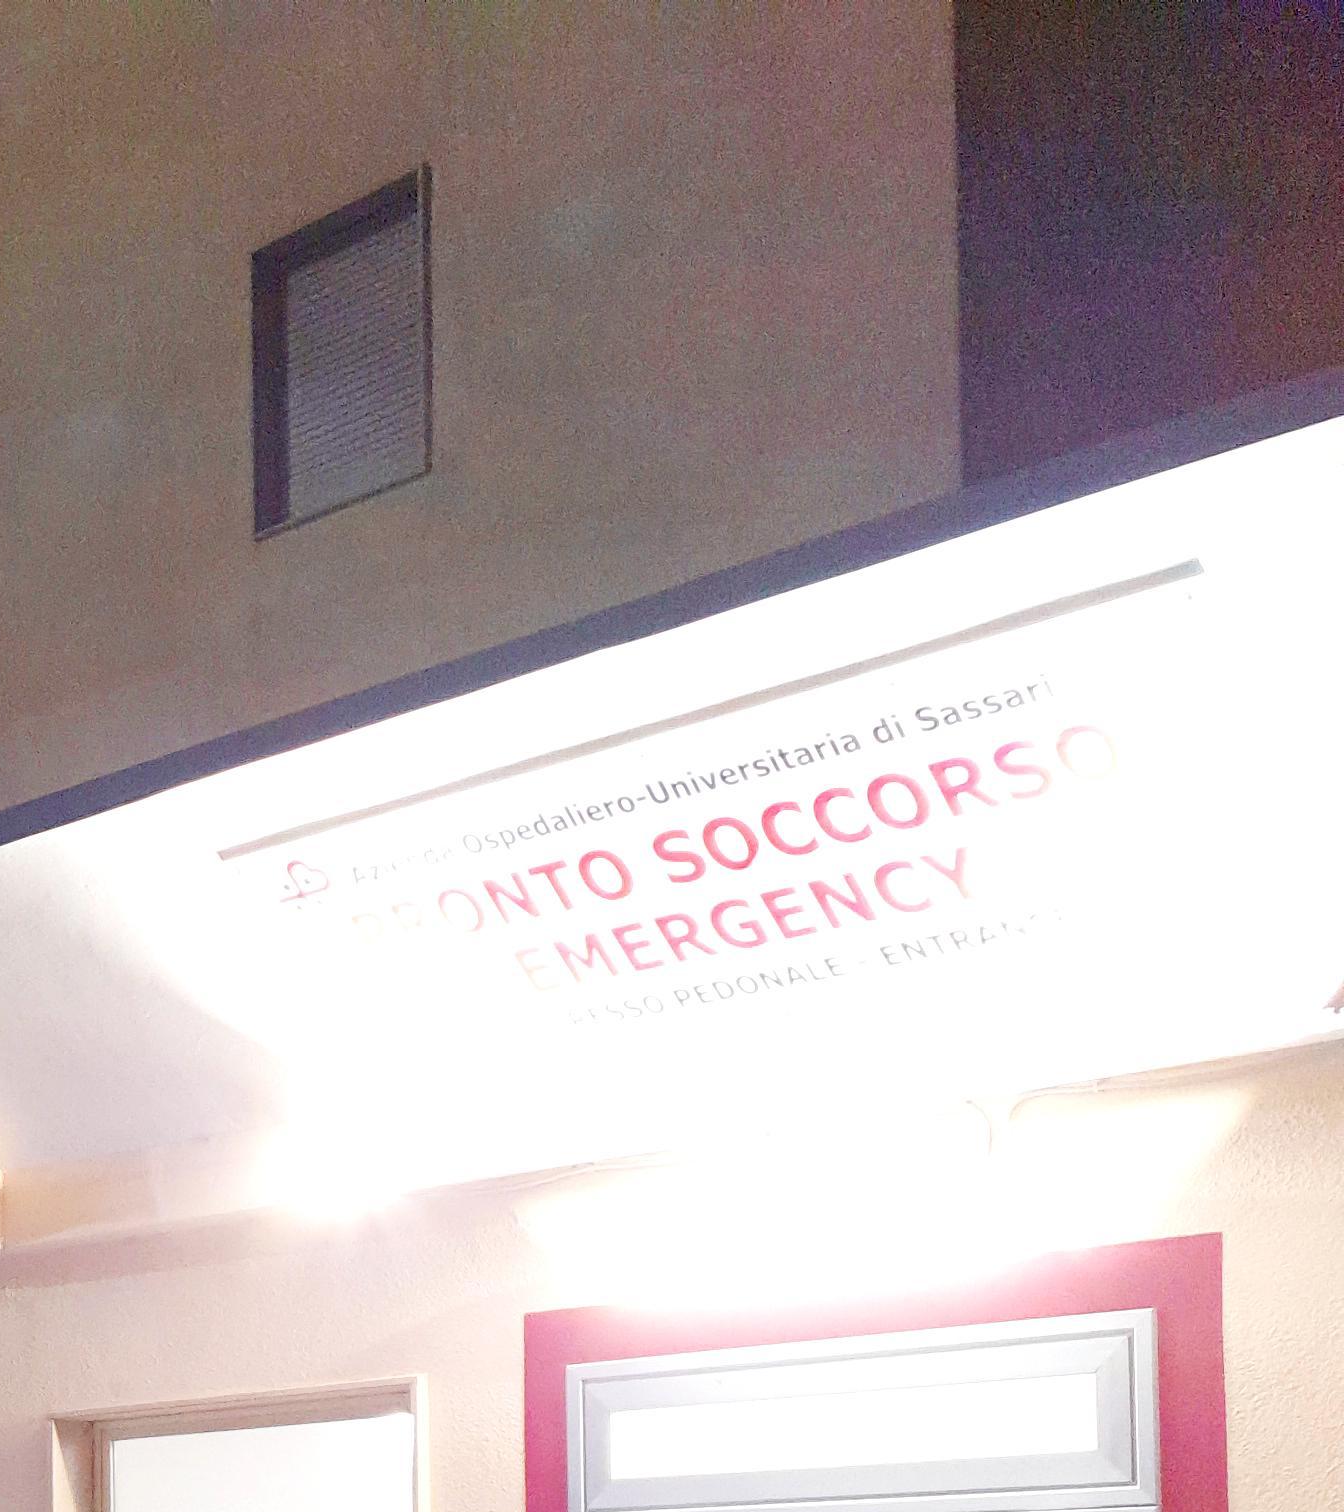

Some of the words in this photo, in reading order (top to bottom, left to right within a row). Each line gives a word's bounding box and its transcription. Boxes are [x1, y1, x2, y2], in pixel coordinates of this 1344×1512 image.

[462, 731, 862, 854] Ospedaliero-Universitaria
[872, 714, 908, 744] di
[914, 673, 1054, 732] Sassari
[651, 724, 1119, 884] SOCCORSO
[514, 846, 972, 991] EMERGENCY
[673, 956, 845, 1010] PEDONALE
